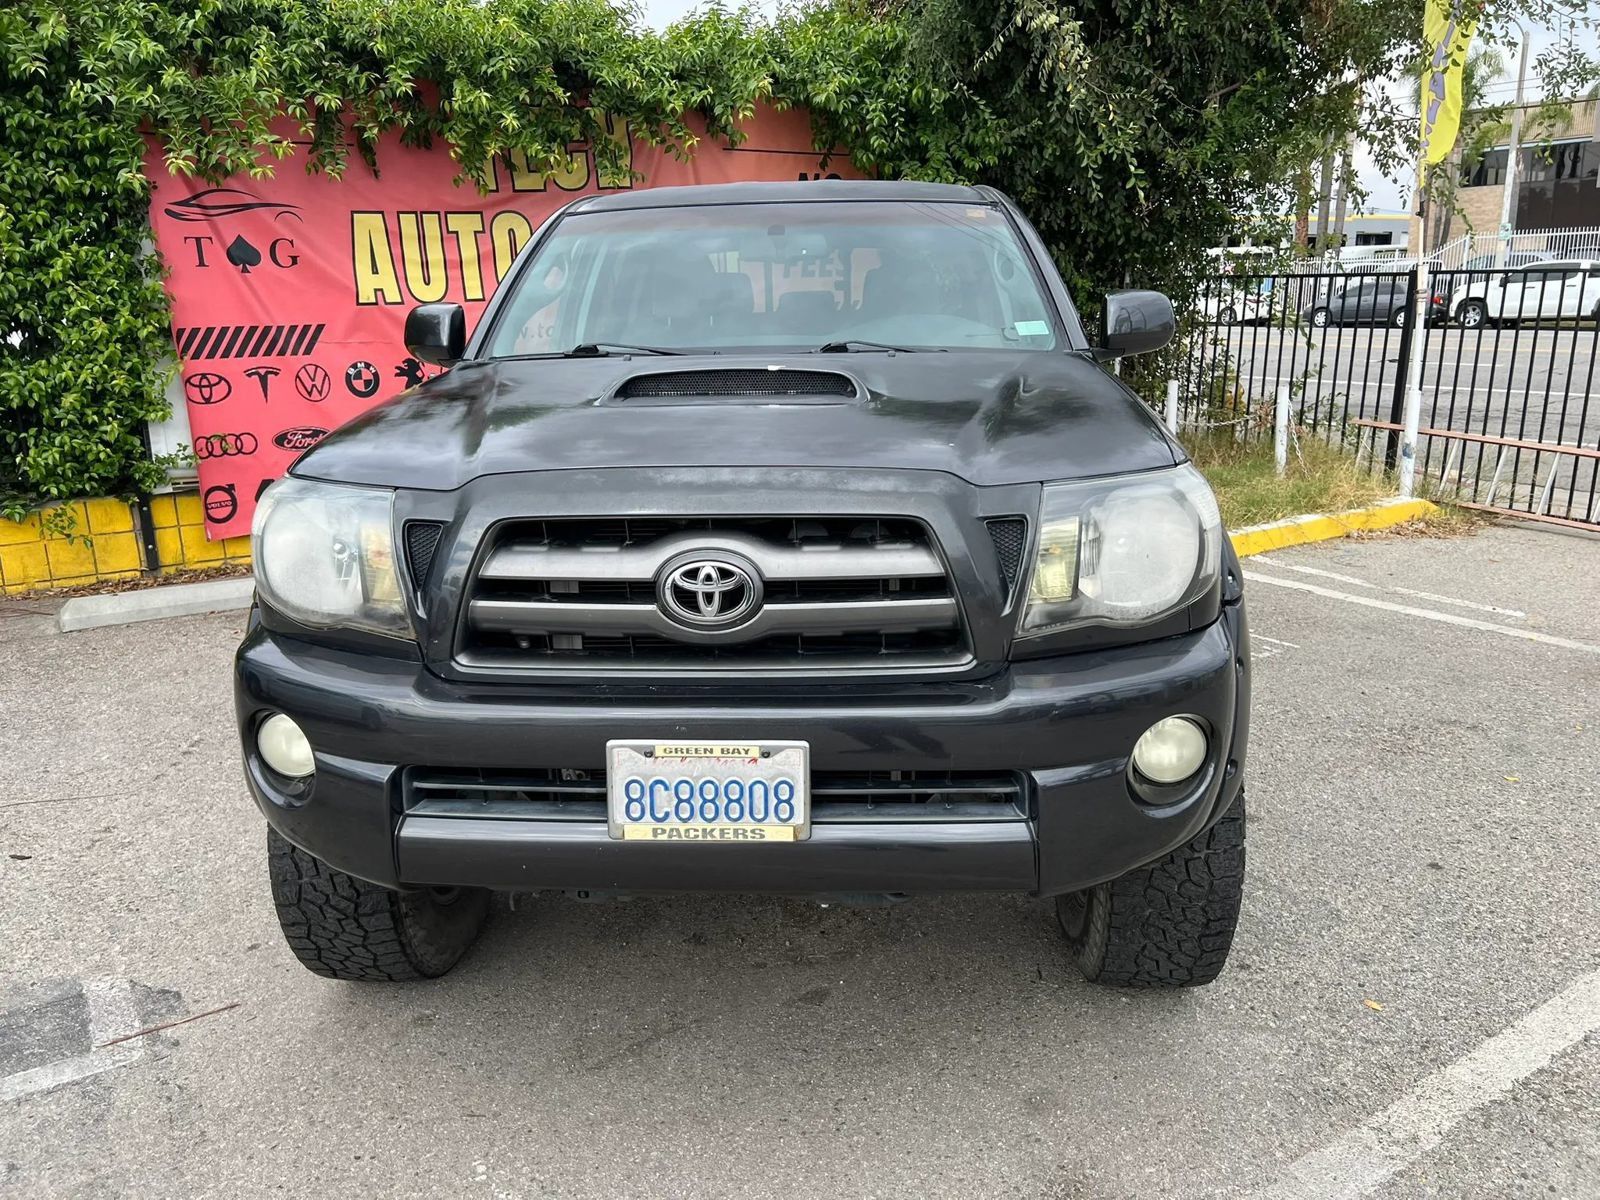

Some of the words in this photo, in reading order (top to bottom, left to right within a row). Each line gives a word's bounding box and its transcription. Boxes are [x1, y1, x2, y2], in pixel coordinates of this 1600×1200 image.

[663, 746, 714, 755] GREEN
[720, 747, 750, 756] BAY
[624, 778, 795, 823] 8C88808
[651, 827, 766, 840] PACKERS
